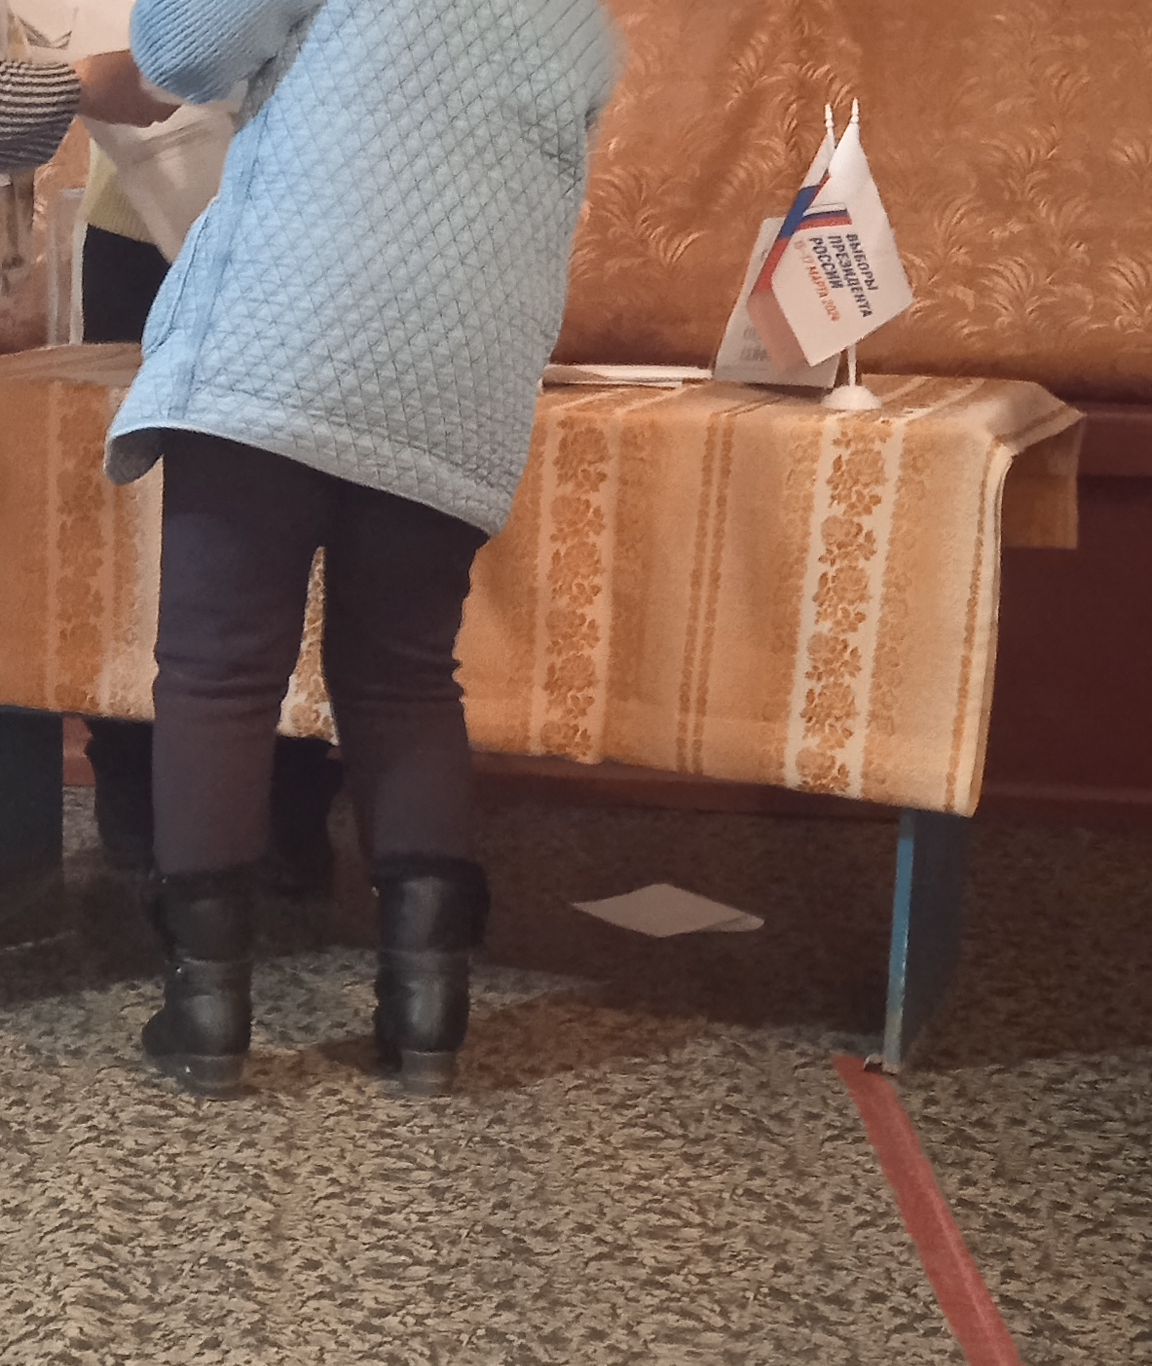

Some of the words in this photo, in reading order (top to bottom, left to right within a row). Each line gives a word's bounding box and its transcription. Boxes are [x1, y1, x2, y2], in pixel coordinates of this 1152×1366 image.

[809, 237, 844, 289] РОССИИ
[828, 235, 873, 317] ПРЕЗИДЕНТА
[846, 233, 879, 290] ВЫБОРЫ
